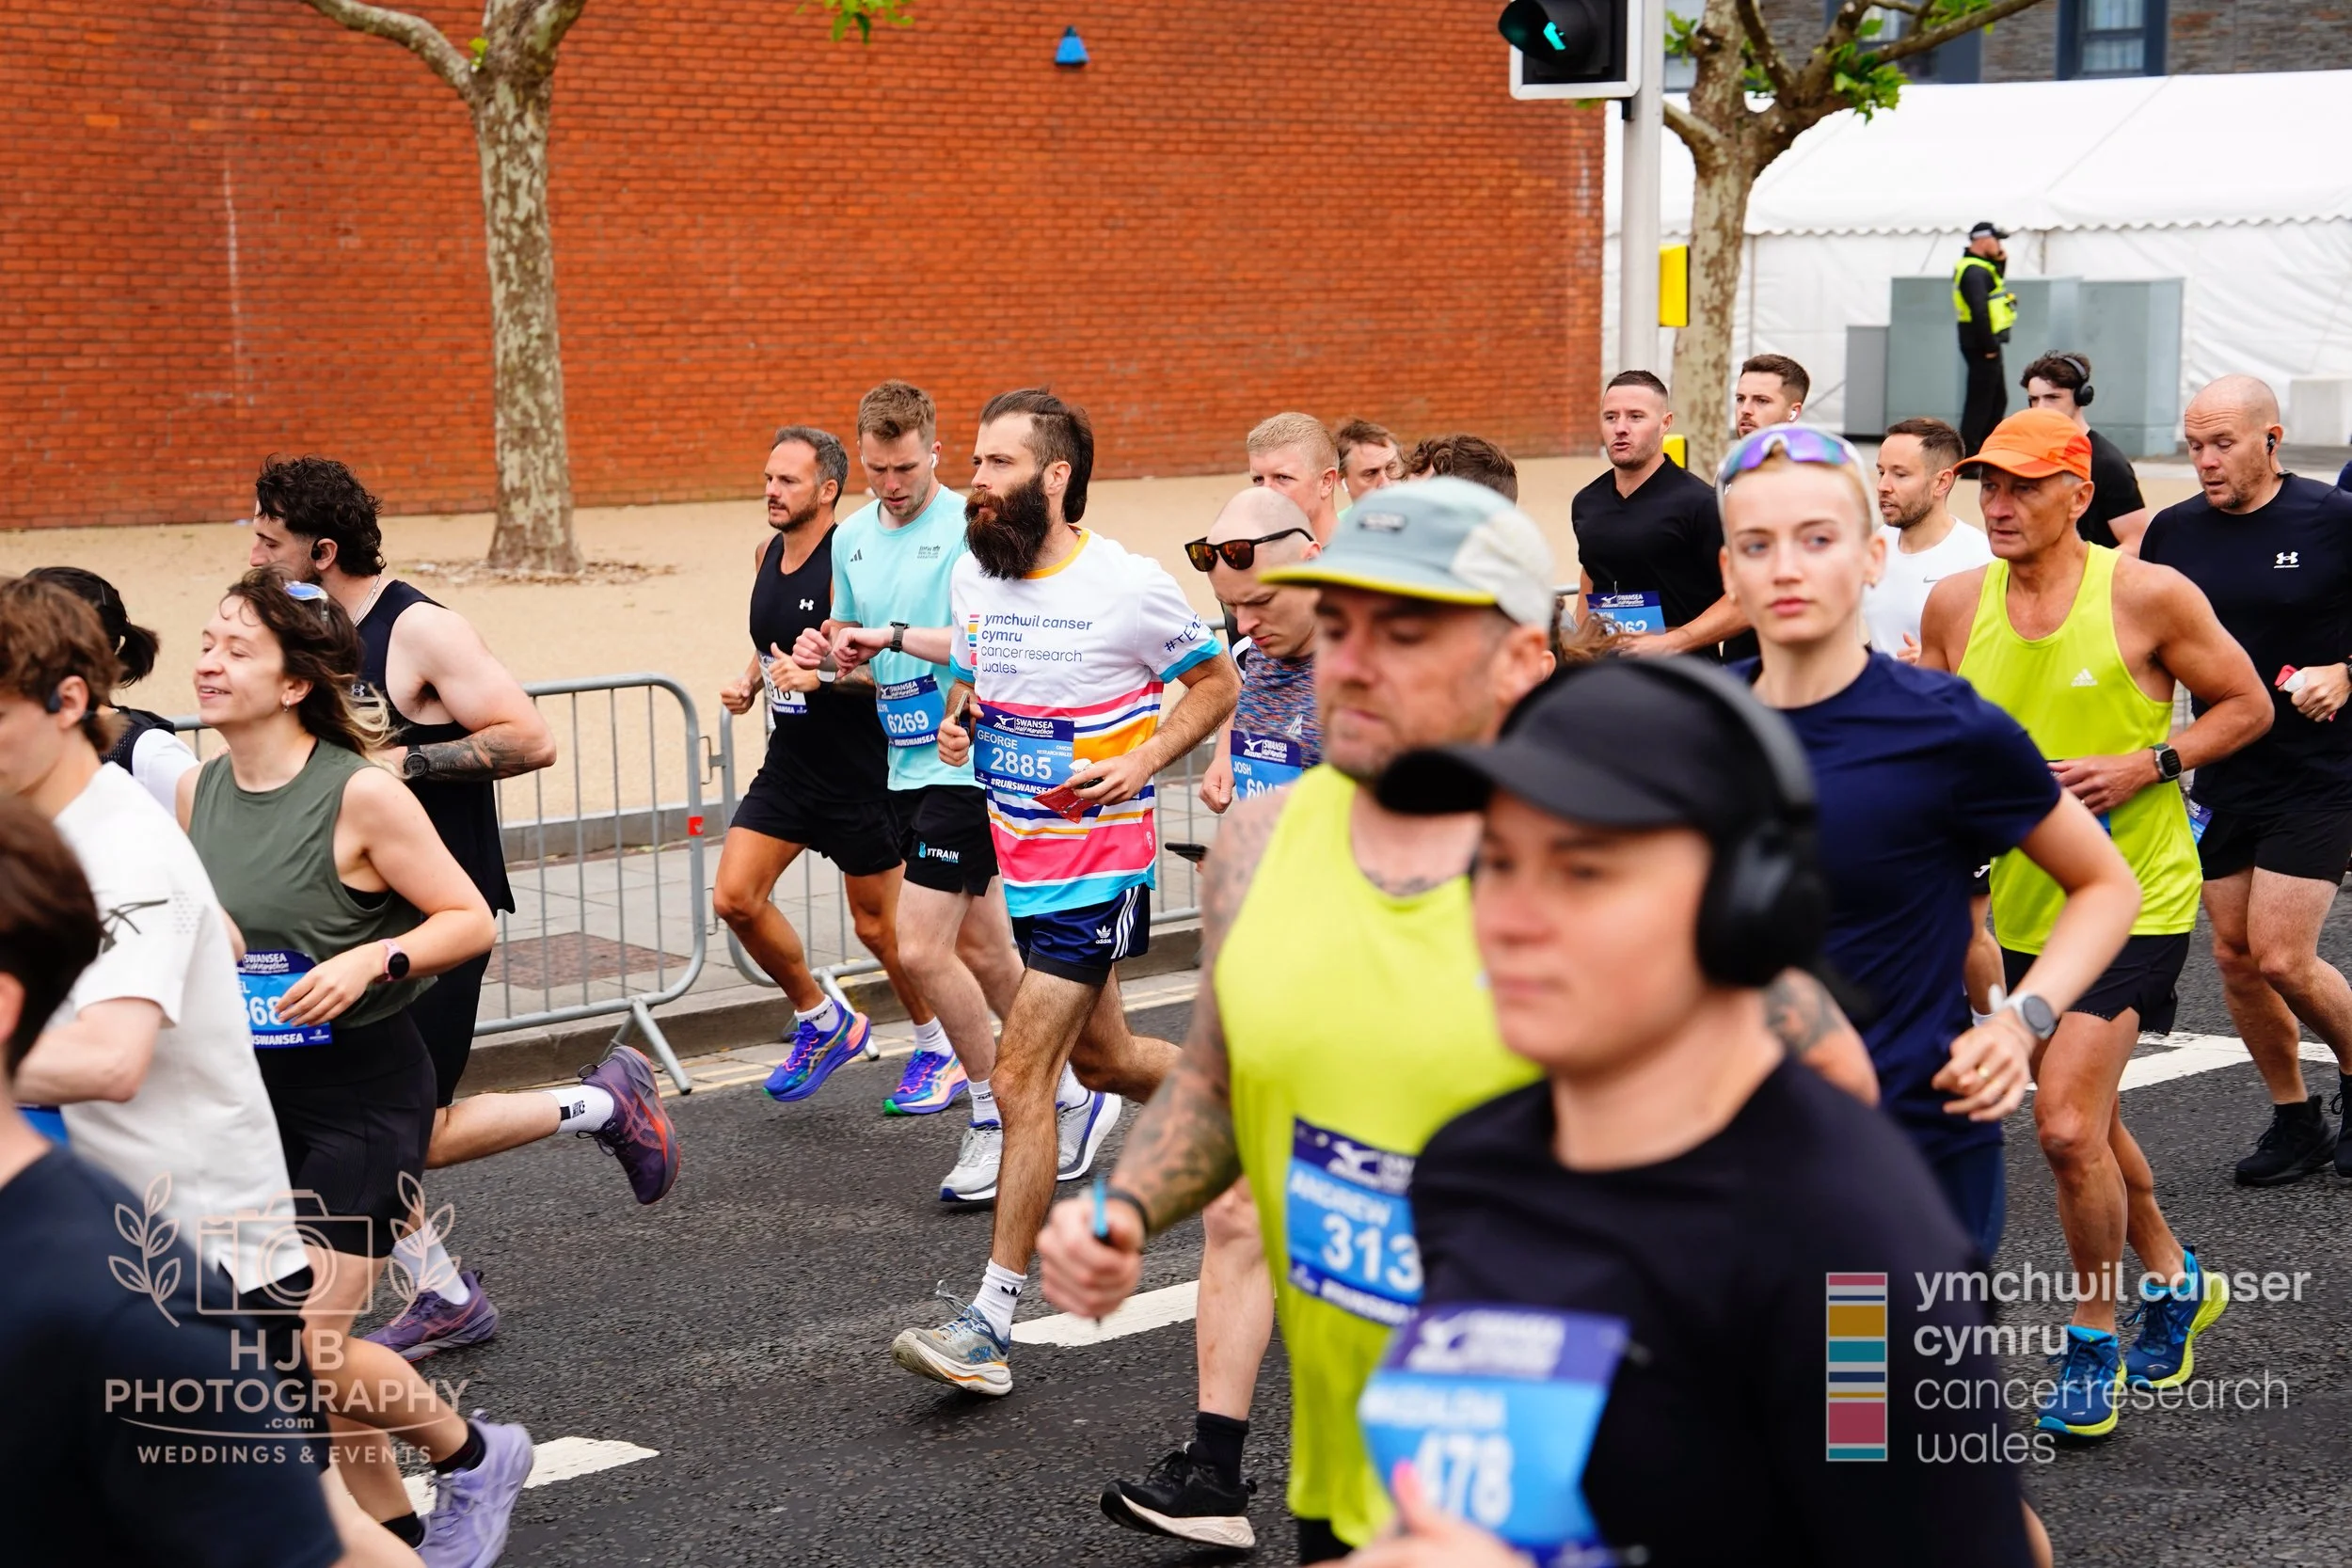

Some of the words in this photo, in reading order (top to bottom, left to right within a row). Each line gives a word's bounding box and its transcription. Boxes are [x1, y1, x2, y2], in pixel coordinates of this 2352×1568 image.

[984, 612, 1040, 627] ymchwil
[1042, 617, 1092, 630] canser
[981, 629, 1023, 643] cymru
[981, 645, 1023, 658] cancer
[1025, 649, 1082, 662] research
[981, 661, 1018, 674] wales
[889, 680, 918, 693] SWANSEA
[887, 709, 930, 734] 6269
[1016, 718, 1054, 729] SWANSEA
[977, 729, 1019, 751] GEORGE
[1263, 739, 1288, 752] SWANSEA
[990, 747, 1053, 780] 2885
[1233, 761, 1252, 776] JOSH
[244, 953, 288, 965] SWANSEA
[1321, 1212, 1425, 1293] 313
